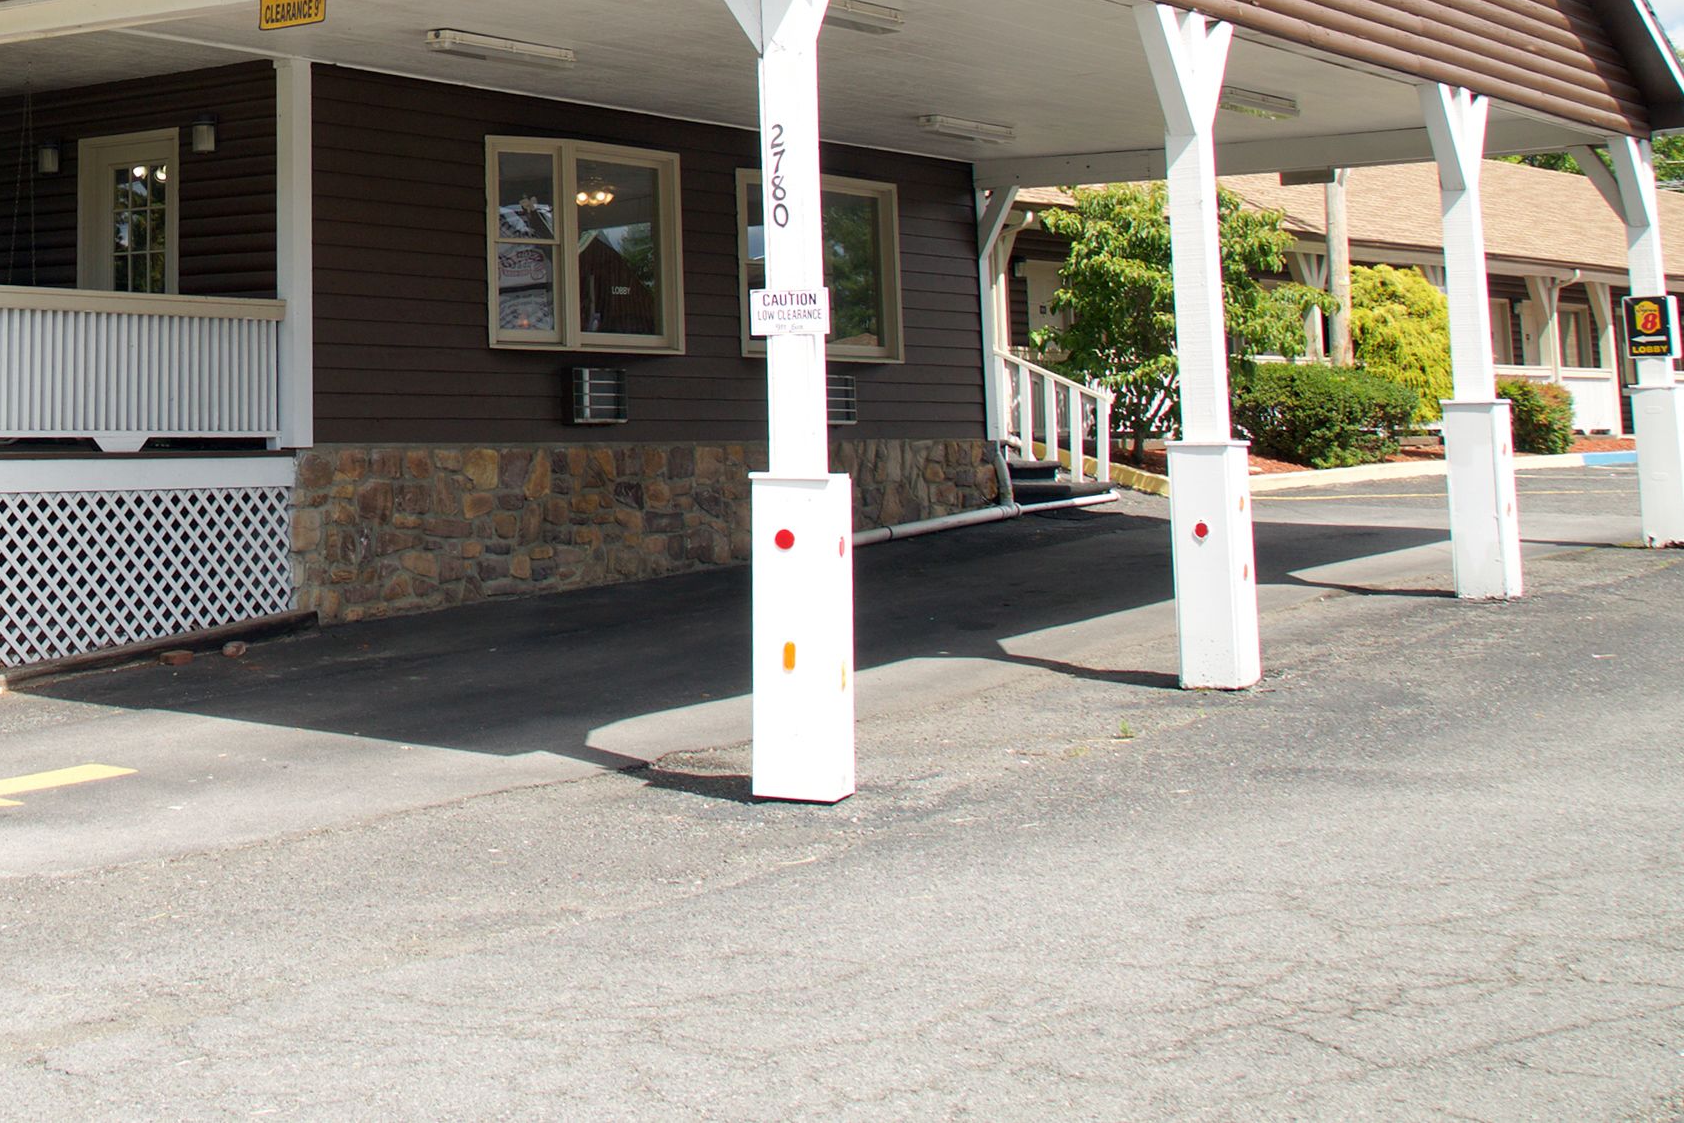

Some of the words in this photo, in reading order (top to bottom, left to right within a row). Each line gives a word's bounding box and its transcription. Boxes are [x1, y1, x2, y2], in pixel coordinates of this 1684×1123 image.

[264, 0, 313, 24] CLEARANCE
[771, 124, 789, 228] 2780
[611, 285, 631, 295] LOBBY
[762, 293, 817, 307] CAUTION
[757, 308, 775, 321] LOW
[777, 308, 822, 320] CLEARANCE
[1641, 312, 1659, 331] 8
[1631, 345, 1669, 354] LOBBY
